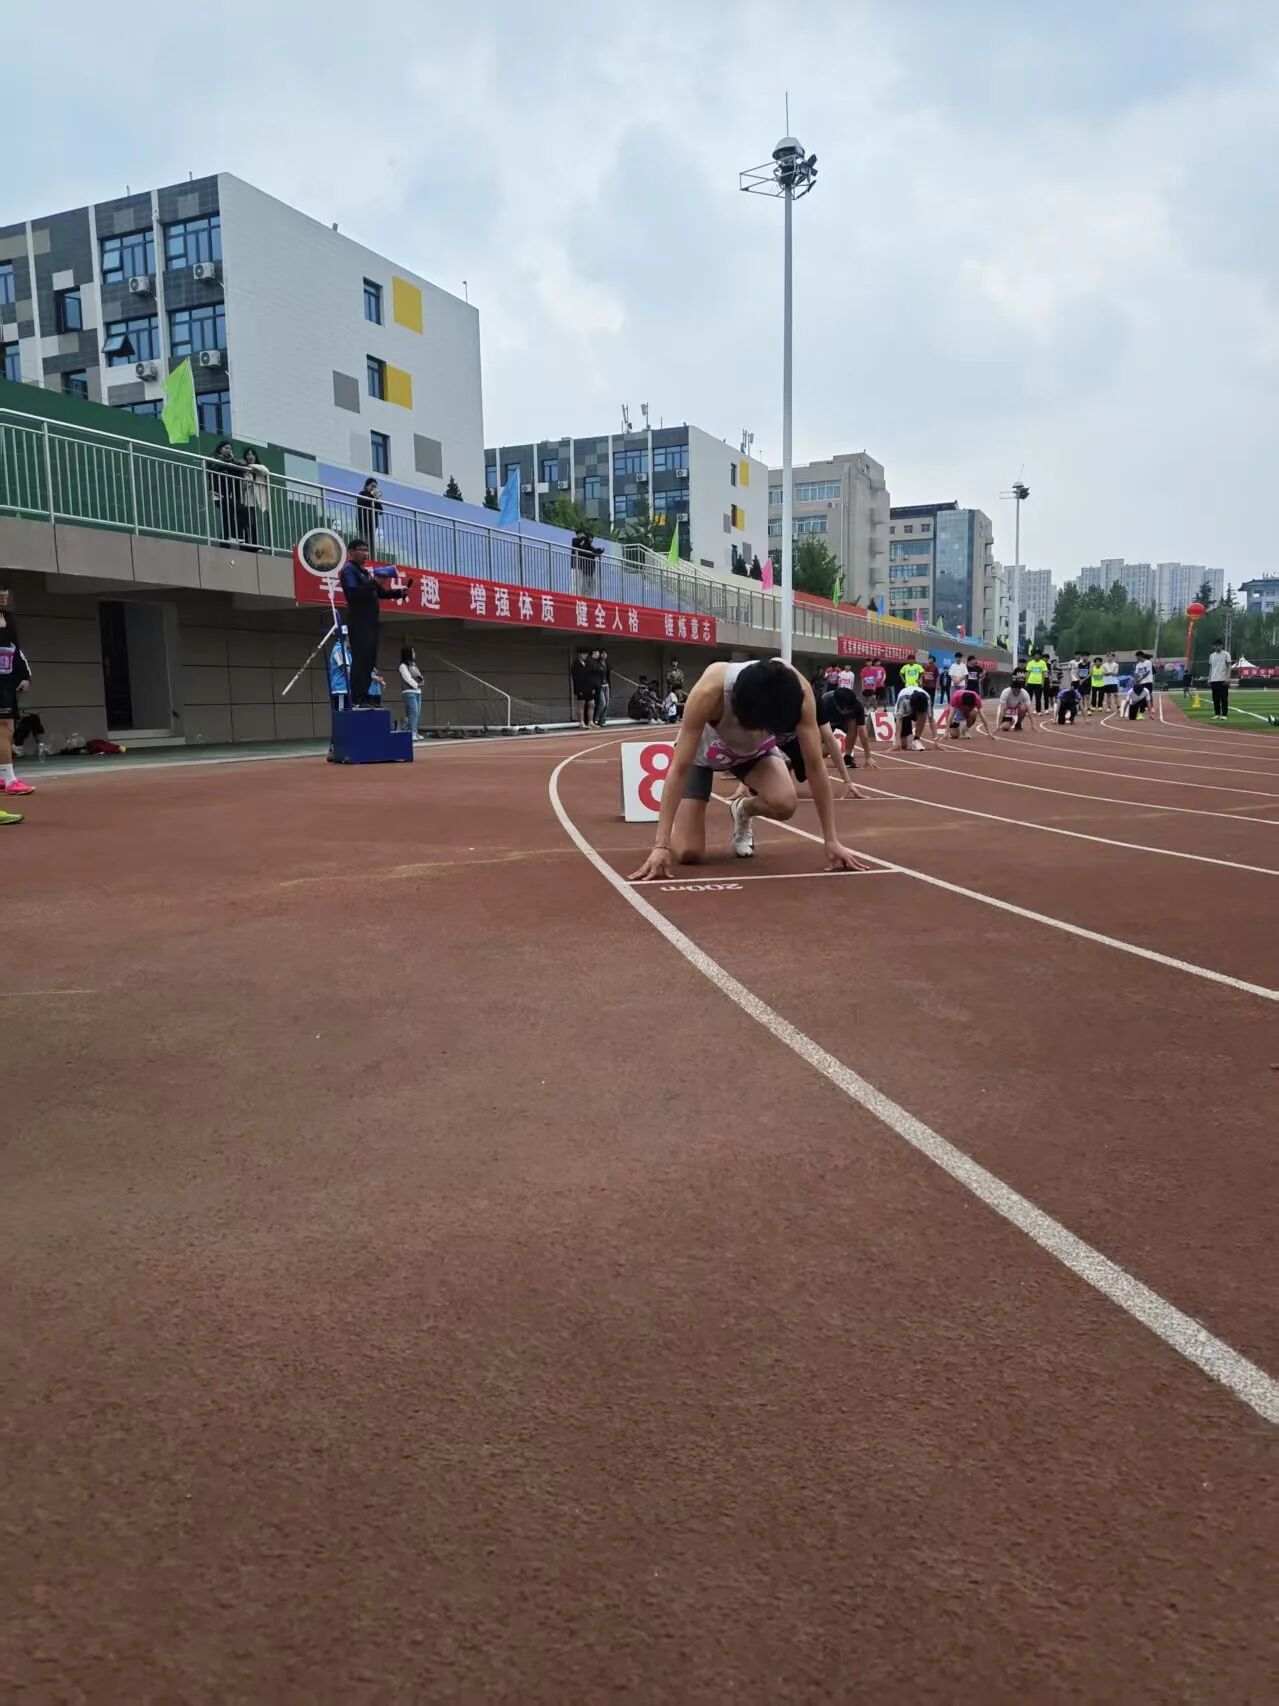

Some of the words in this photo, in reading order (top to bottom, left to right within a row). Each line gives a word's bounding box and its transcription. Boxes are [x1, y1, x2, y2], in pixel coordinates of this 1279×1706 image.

[469, 583, 555, 623] 增强体质
[575, 600, 640, 633] 健全人格
[664, 613, 711, 642] 锤炼意志
[874, 711, 894, 741] 5
[638, 743, 676, 812] 8
[660, 882, 744, 892] 200m
